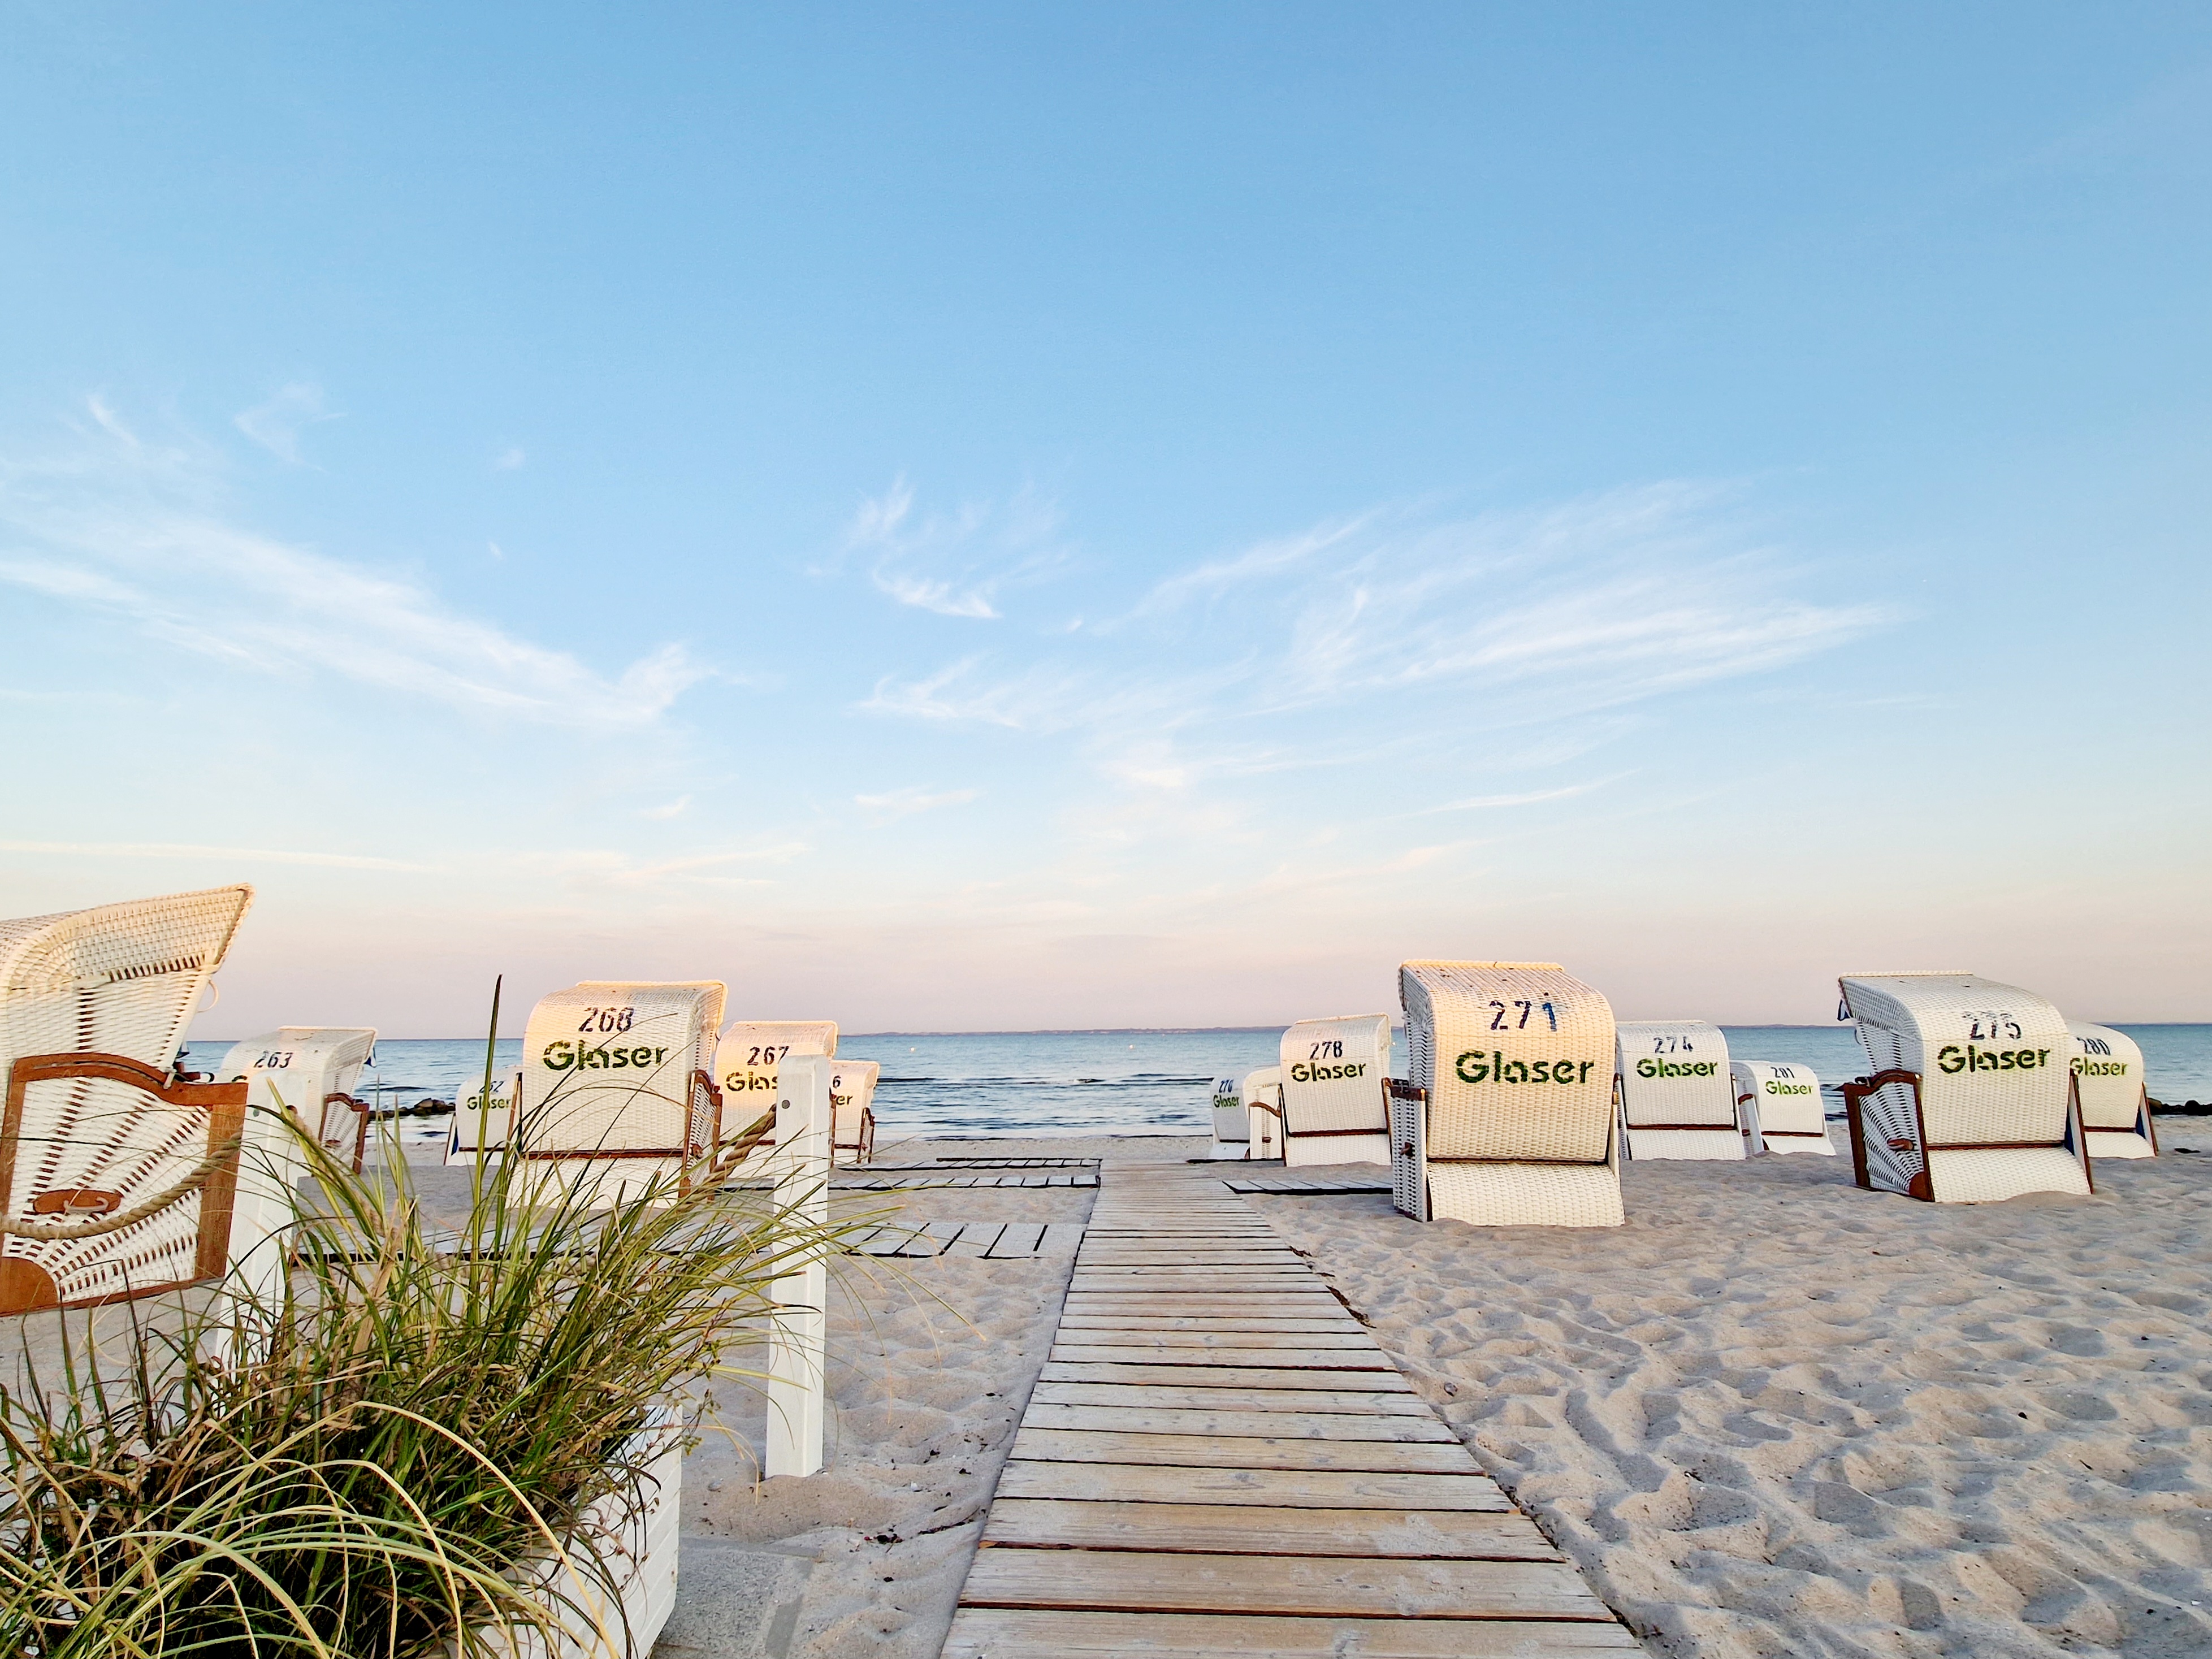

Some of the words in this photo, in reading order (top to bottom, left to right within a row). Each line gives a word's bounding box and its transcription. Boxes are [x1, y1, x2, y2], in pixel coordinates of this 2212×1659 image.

[578, 1007, 634, 1032] 268
[1489, 999, 1557, 1032] 271
[1962, 1011, 2021, 1040] 275
[542, 1039, 668, 1070] Glaser
[1309, 1040, 1343, 1060] 278
[1653, 1036, 1694, 1054] 274
[2076, 1037, 2111, 1056] 280
[253, 1050, 293, 1068] 263
[747, 1046, 789, 1066] 267
[1937, 1045, 2050, 1074] Glaser
[1291, 1062, 1366, 1082] Glaser
[1456, 1051, 1594, 1084] Glaser
[1637, 1058, 1718, 1078] Glaser
[2070, 1057, 2128, 1076] Glaser
[726, 1071, 777, 1091] Glas
[1765, 1080, 1813, 1095] Glaser
[467, 1096, 511, 1110] Glser
[1213, 1094, 1240, 1108] Glaser
